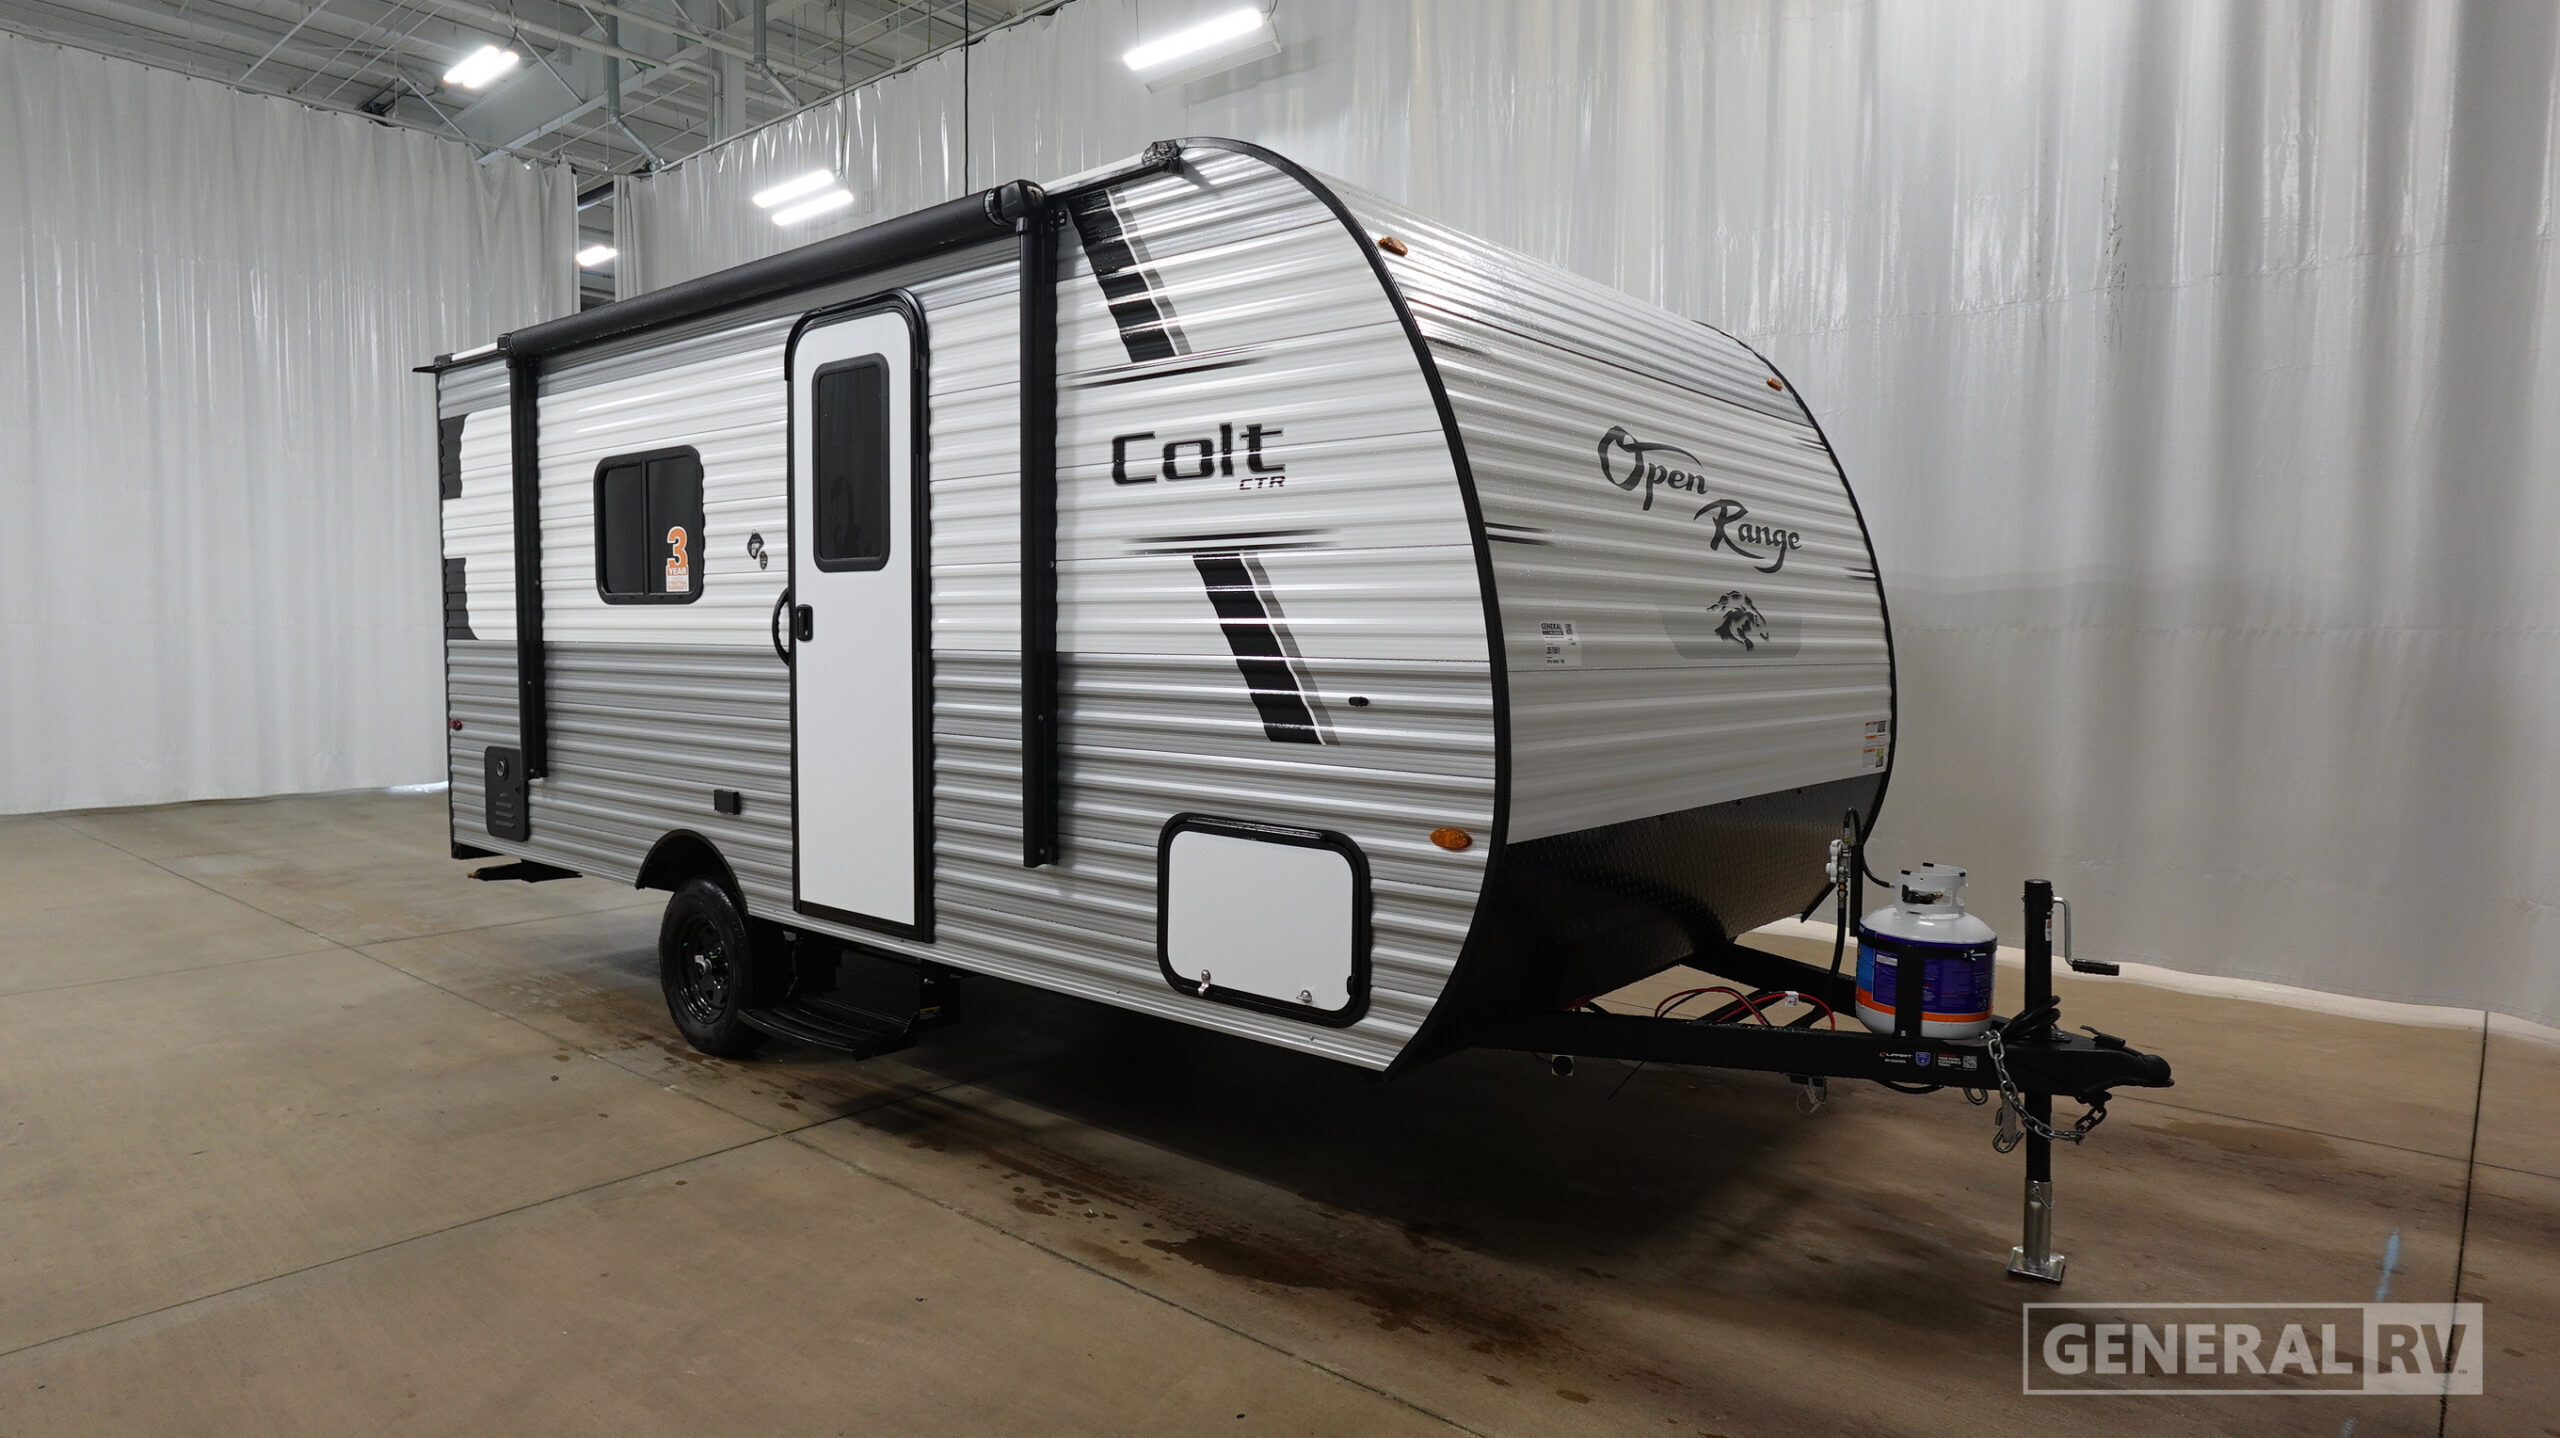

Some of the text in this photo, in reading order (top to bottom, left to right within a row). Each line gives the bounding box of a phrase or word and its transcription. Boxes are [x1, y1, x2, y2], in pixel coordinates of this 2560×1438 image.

[1111, 422, 1286, 486] Colt
[1598, 425, 1708, 511] Open
[1239, 475, 1286, 491] CTR
[667, 526, 688, 567] 3
[1693, 498, 1802, 574] Range
[668, 567, 688, 575] YEAR
